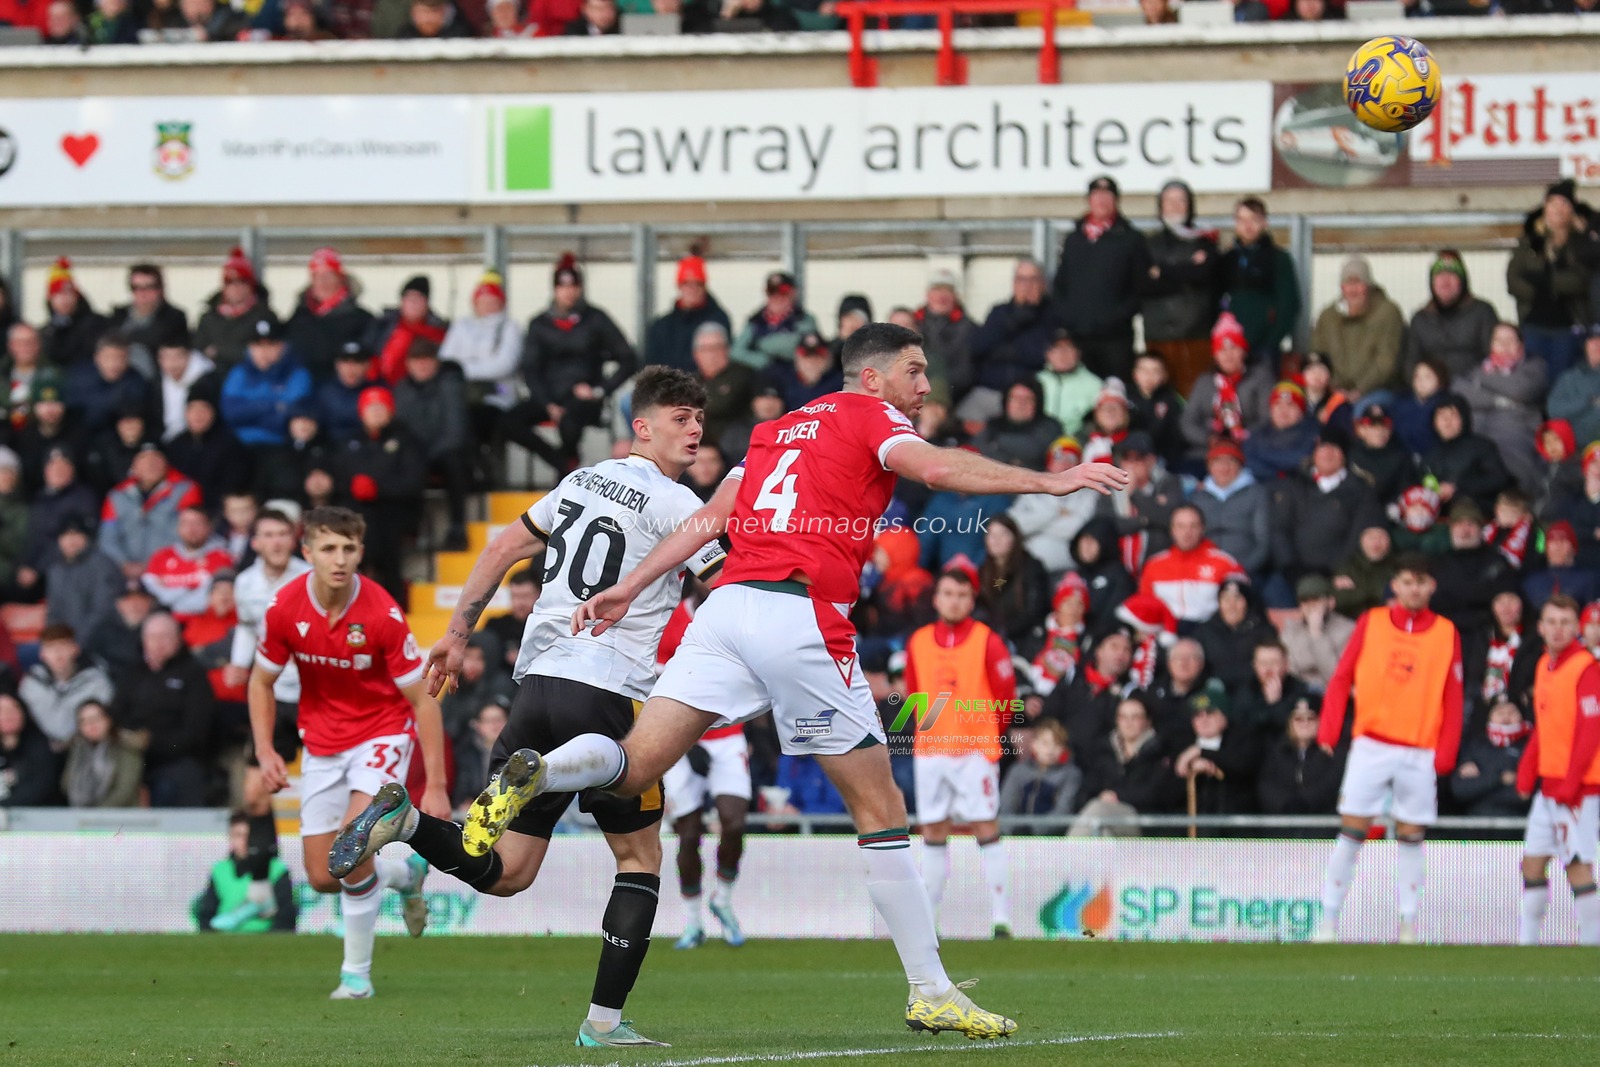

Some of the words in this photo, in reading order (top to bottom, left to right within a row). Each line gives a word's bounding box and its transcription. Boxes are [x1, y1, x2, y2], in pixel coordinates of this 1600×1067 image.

[586, 109, 833, 190] lawray
[863, 101, 1247, 172] architects
[752, 449, 801, 532] 4
[541, 498, 627, 602] 30
[366, 743, 402, 779] 32
[1120, 887, 1178, 928] SP
